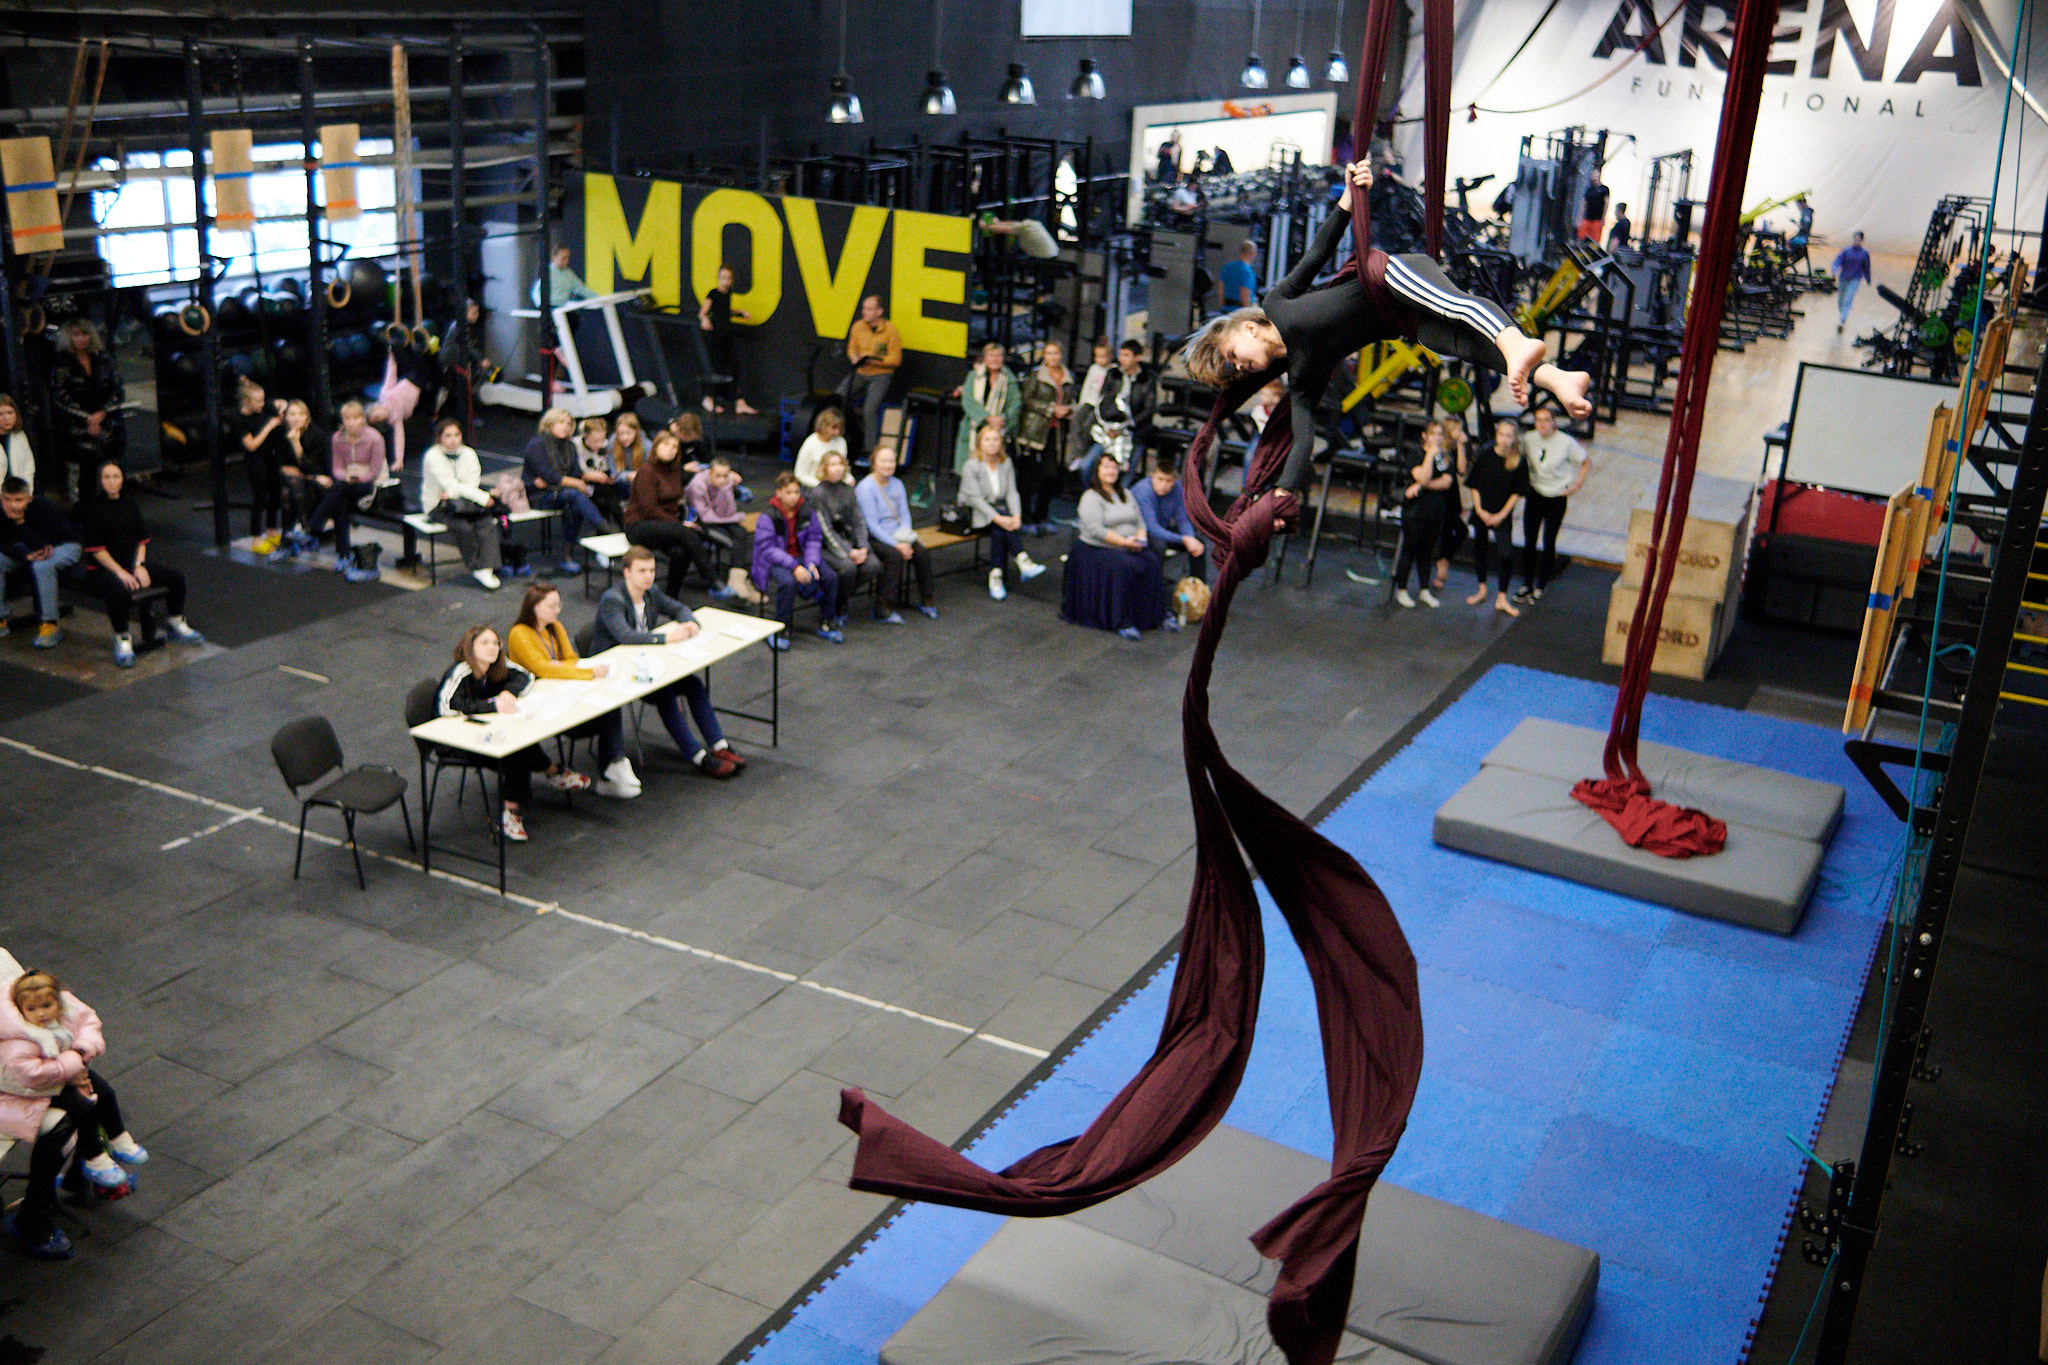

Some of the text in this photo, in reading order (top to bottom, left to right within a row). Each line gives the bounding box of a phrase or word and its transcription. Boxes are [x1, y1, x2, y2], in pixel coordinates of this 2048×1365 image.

[1592, 0, 1982, 87] ARENA
[1631, 76, 1926, 118] FUNIONAL
[584, 172, 972, 358] MOVE
[1634, 542, 1721, 570] RORD
[1616, 620, 1700, 648] RORD
